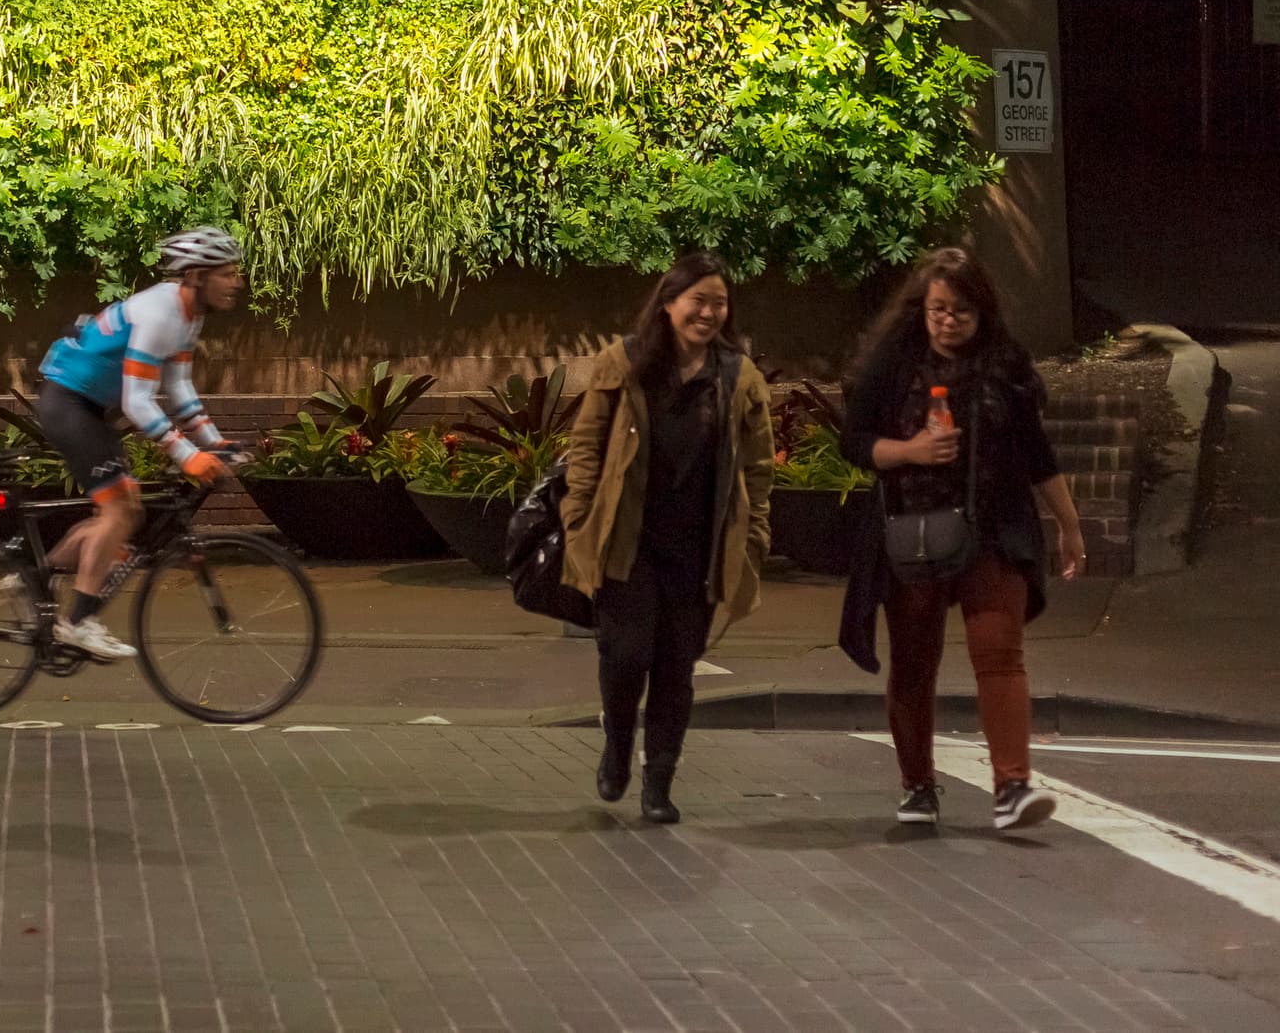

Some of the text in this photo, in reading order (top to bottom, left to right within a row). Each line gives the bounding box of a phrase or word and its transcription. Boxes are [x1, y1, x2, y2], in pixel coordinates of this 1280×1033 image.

[1002, 60, 1045, 99] 157
[1002, 104, 1048, 121] GEORGE
[1004, 126, 1047, 142] STREET
